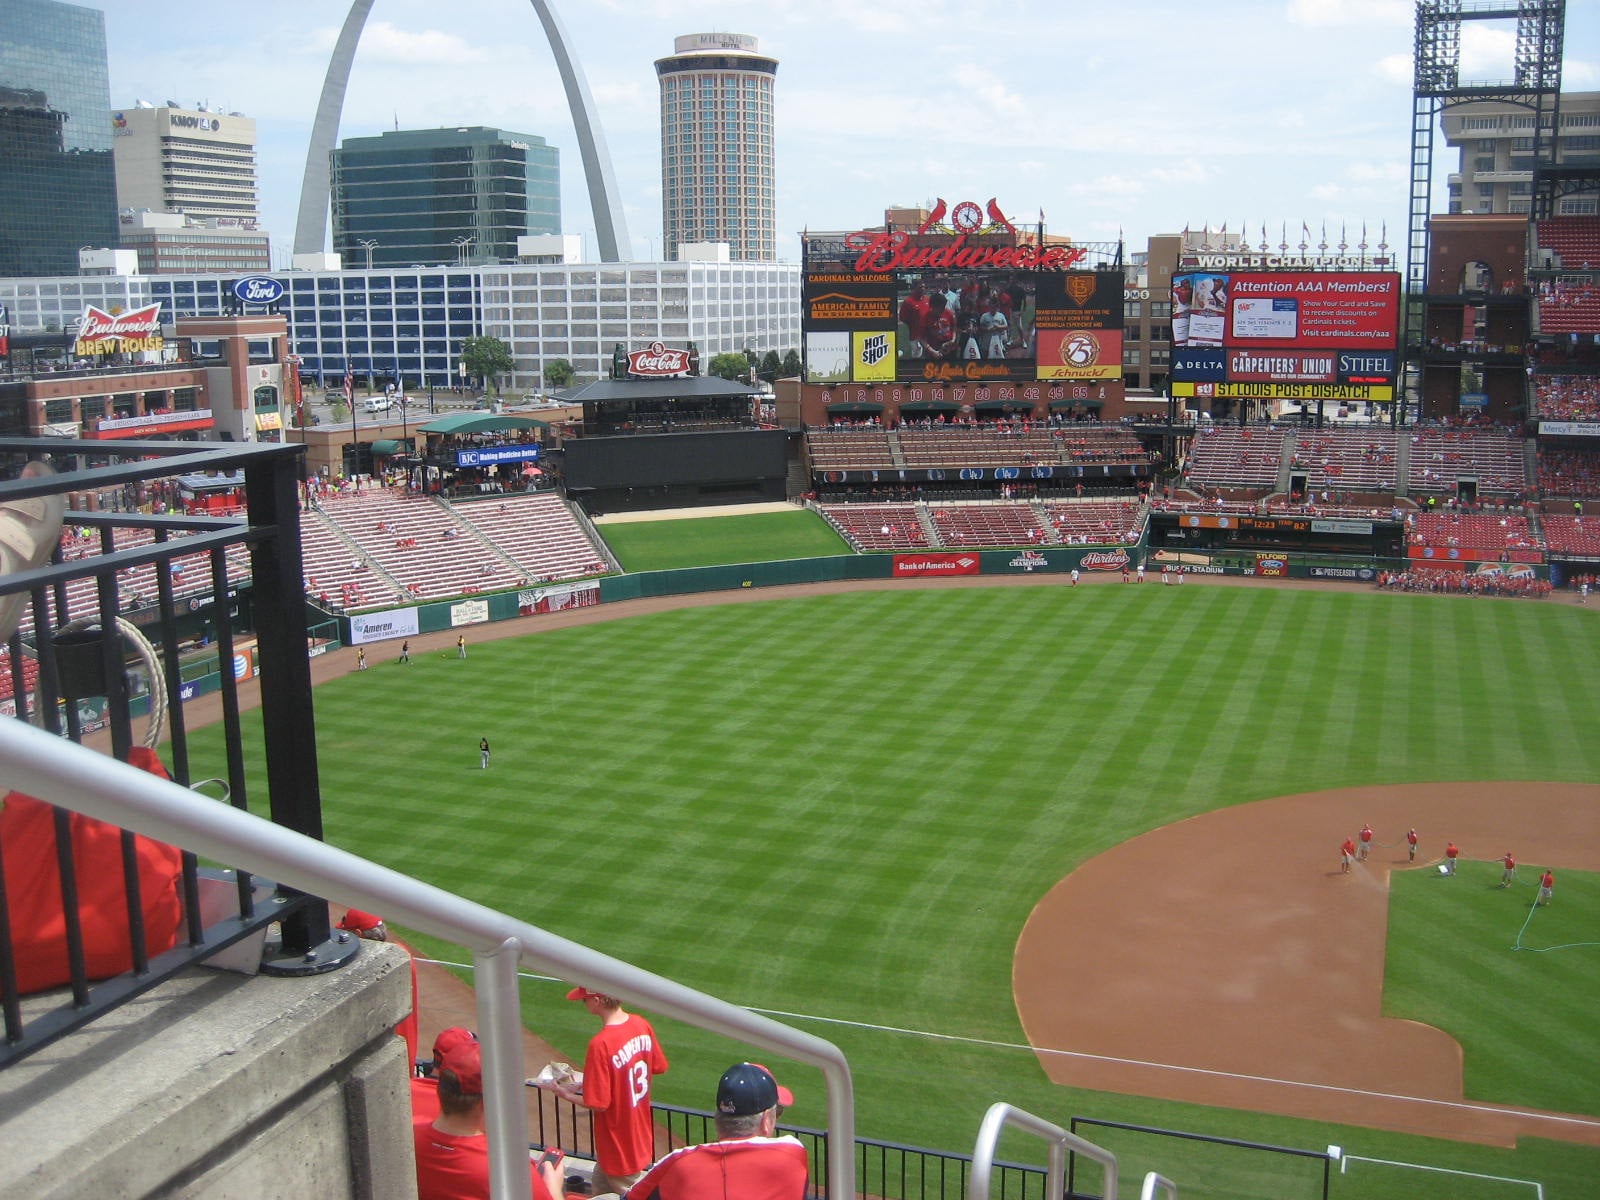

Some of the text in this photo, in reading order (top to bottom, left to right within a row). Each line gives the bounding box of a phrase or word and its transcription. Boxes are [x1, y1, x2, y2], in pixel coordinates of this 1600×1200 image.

[171, 115, 198, 128] KMOV
[845, 231, 1088, 272] Budweiser
[1197, 256, 1375, 268] WORLD CHAMPIONS
[808, 274, 892, 282] CARDINALS WELCOME
[246, 280, 275, 298] Ford
[1233, 282, 1390, 292] Attention AAA Members!
[858, 302, 889, 310] FAMILY
[74, 316, 160, 337] Budweiser
[1320, 330, 1390, 338] cardinals.com/aaa
[77, 336, 164, 356] BREW HOUSE
[864, 334, 885, 350] HOT
[862, 344, 889, 364] SHOT
[1068, 341, 1092, 362] 75
[1232, 357, 1332, 374] CARPENTERS' UNION
[1340, 356, 1392, 372] STIFEL
[1051, 368, 1108, 377] Schnucks
[844, 390, 849, 402] 1
[858, 390, 866, 402] 2
[875, 390, 884, 402] 6
[892, 389, 900, 402] 9
[910, 389, 923, 401] 10
[931, 388, 944, 401] 14
[953, 388, 966, 401] 17
[975, 388, 991, 400] 20
[998, 388, 1015, 400] 24
[1024, 387, 1040, 400] 42
[1048, 387, 1064, 400] 45
[1218, 384, 1234, 395] ST.
[1238, 384, 1272, 396] LOUIS
[1276, 384, 1370, 398] POST-DISPATCH
[1544, 424, 1567, 432] Mercy
[461, 454, 477, 464] BJC
[499, 451, 521, 459] Medicine
[1324, 568, 1356, 577] POSTSEASON
[363, 622, 392, 634] Ameren
[629, 1060, 648, 1108] 13
